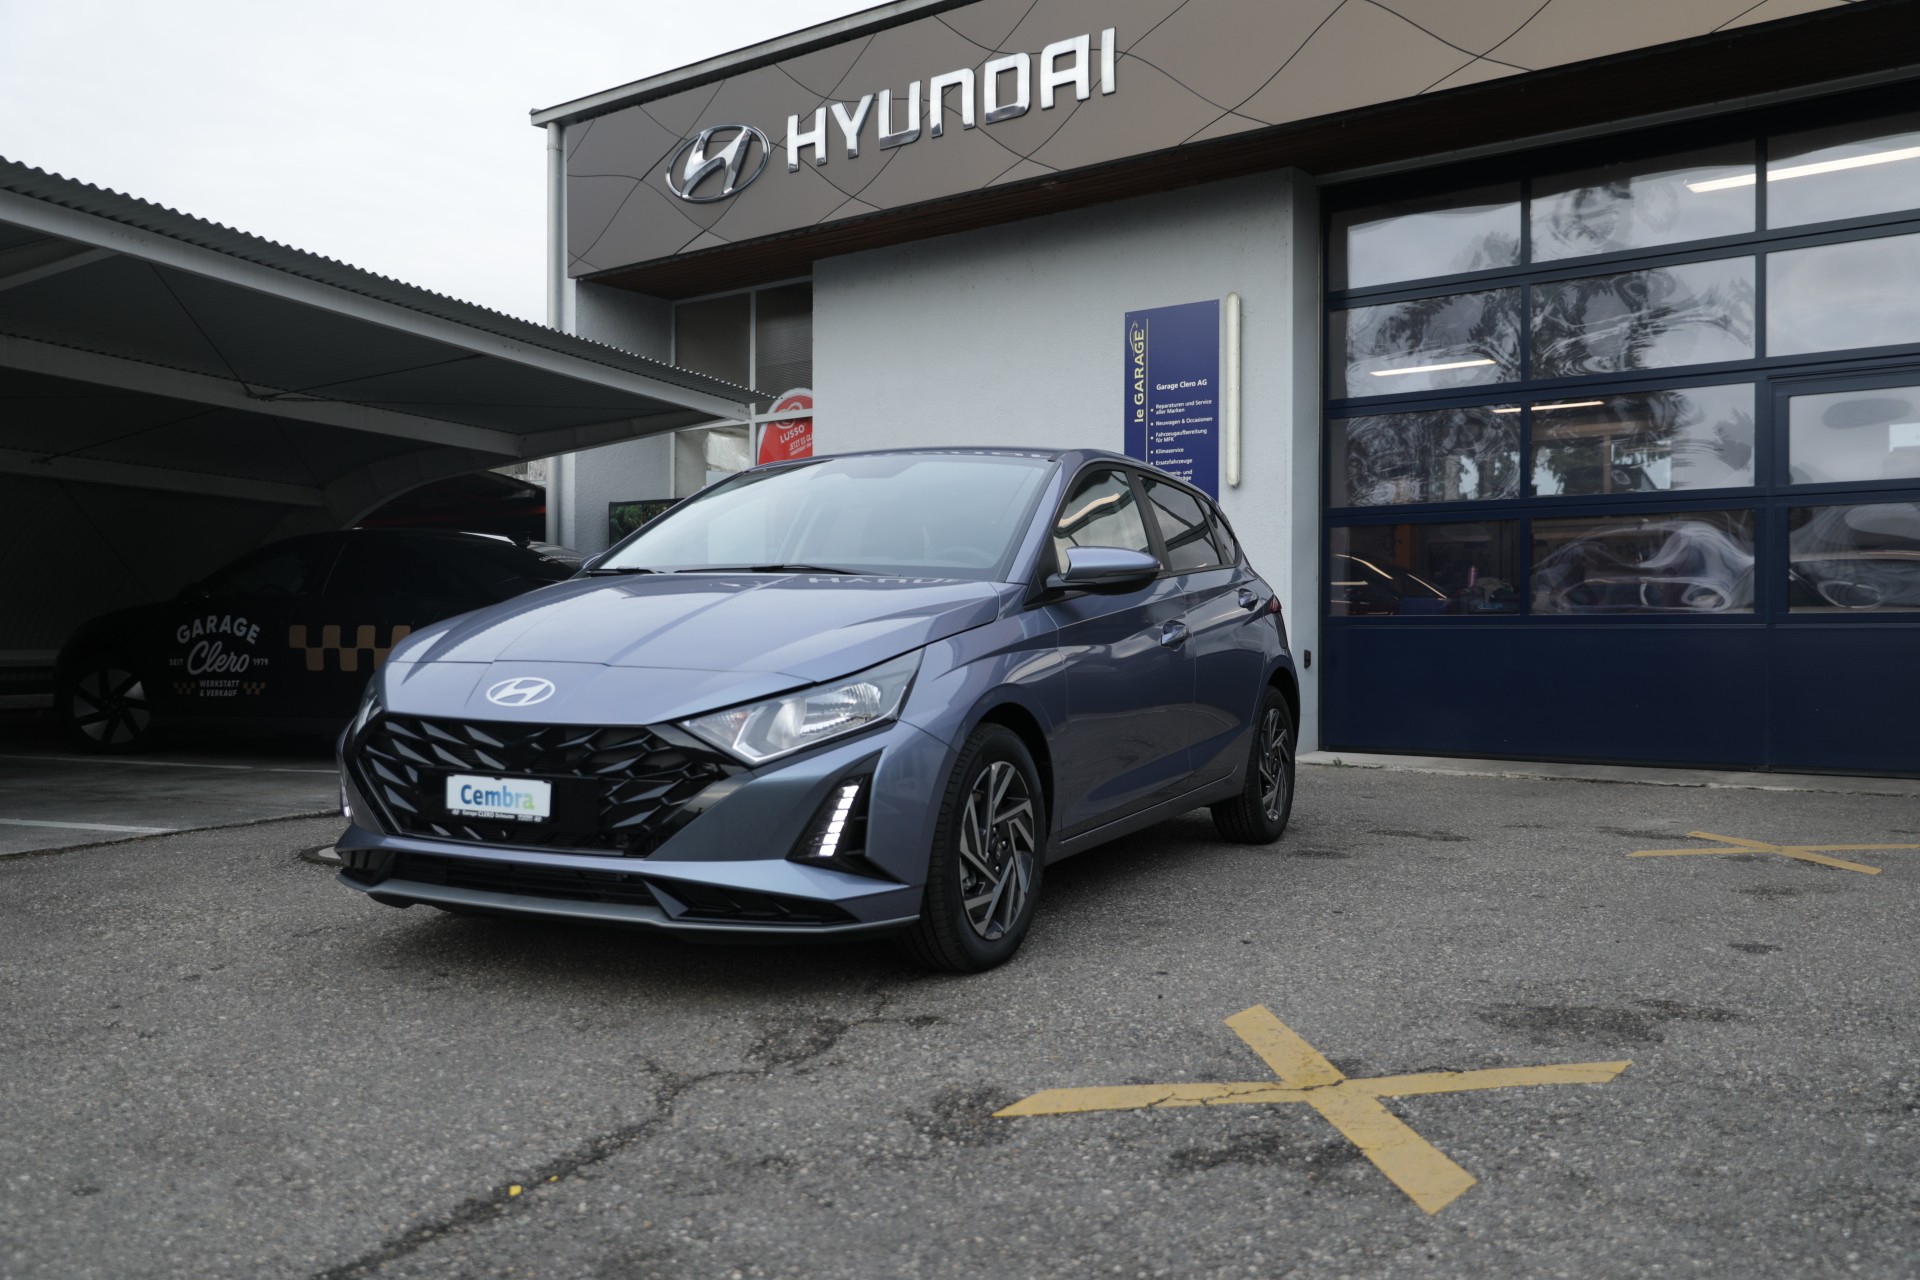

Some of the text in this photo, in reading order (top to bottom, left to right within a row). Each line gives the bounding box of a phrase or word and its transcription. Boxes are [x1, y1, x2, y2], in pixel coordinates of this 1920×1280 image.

[786, 27, 1116, 173] HYUNDAI
[1134, 329, 1144, 423] le GARAGE
[1179, 380, 1197, 388] Clero
[779, 424, 805, 444] LUSSO
[176, 614, 261, 645] GARAGE
[168, 640, 269, 675] SEIT Clero 1979
[199, 680, 240, 688] WERKSTATT
[206, 689, 238, 697] VERKAUF
[460, 784, 535, 810] Cembra
